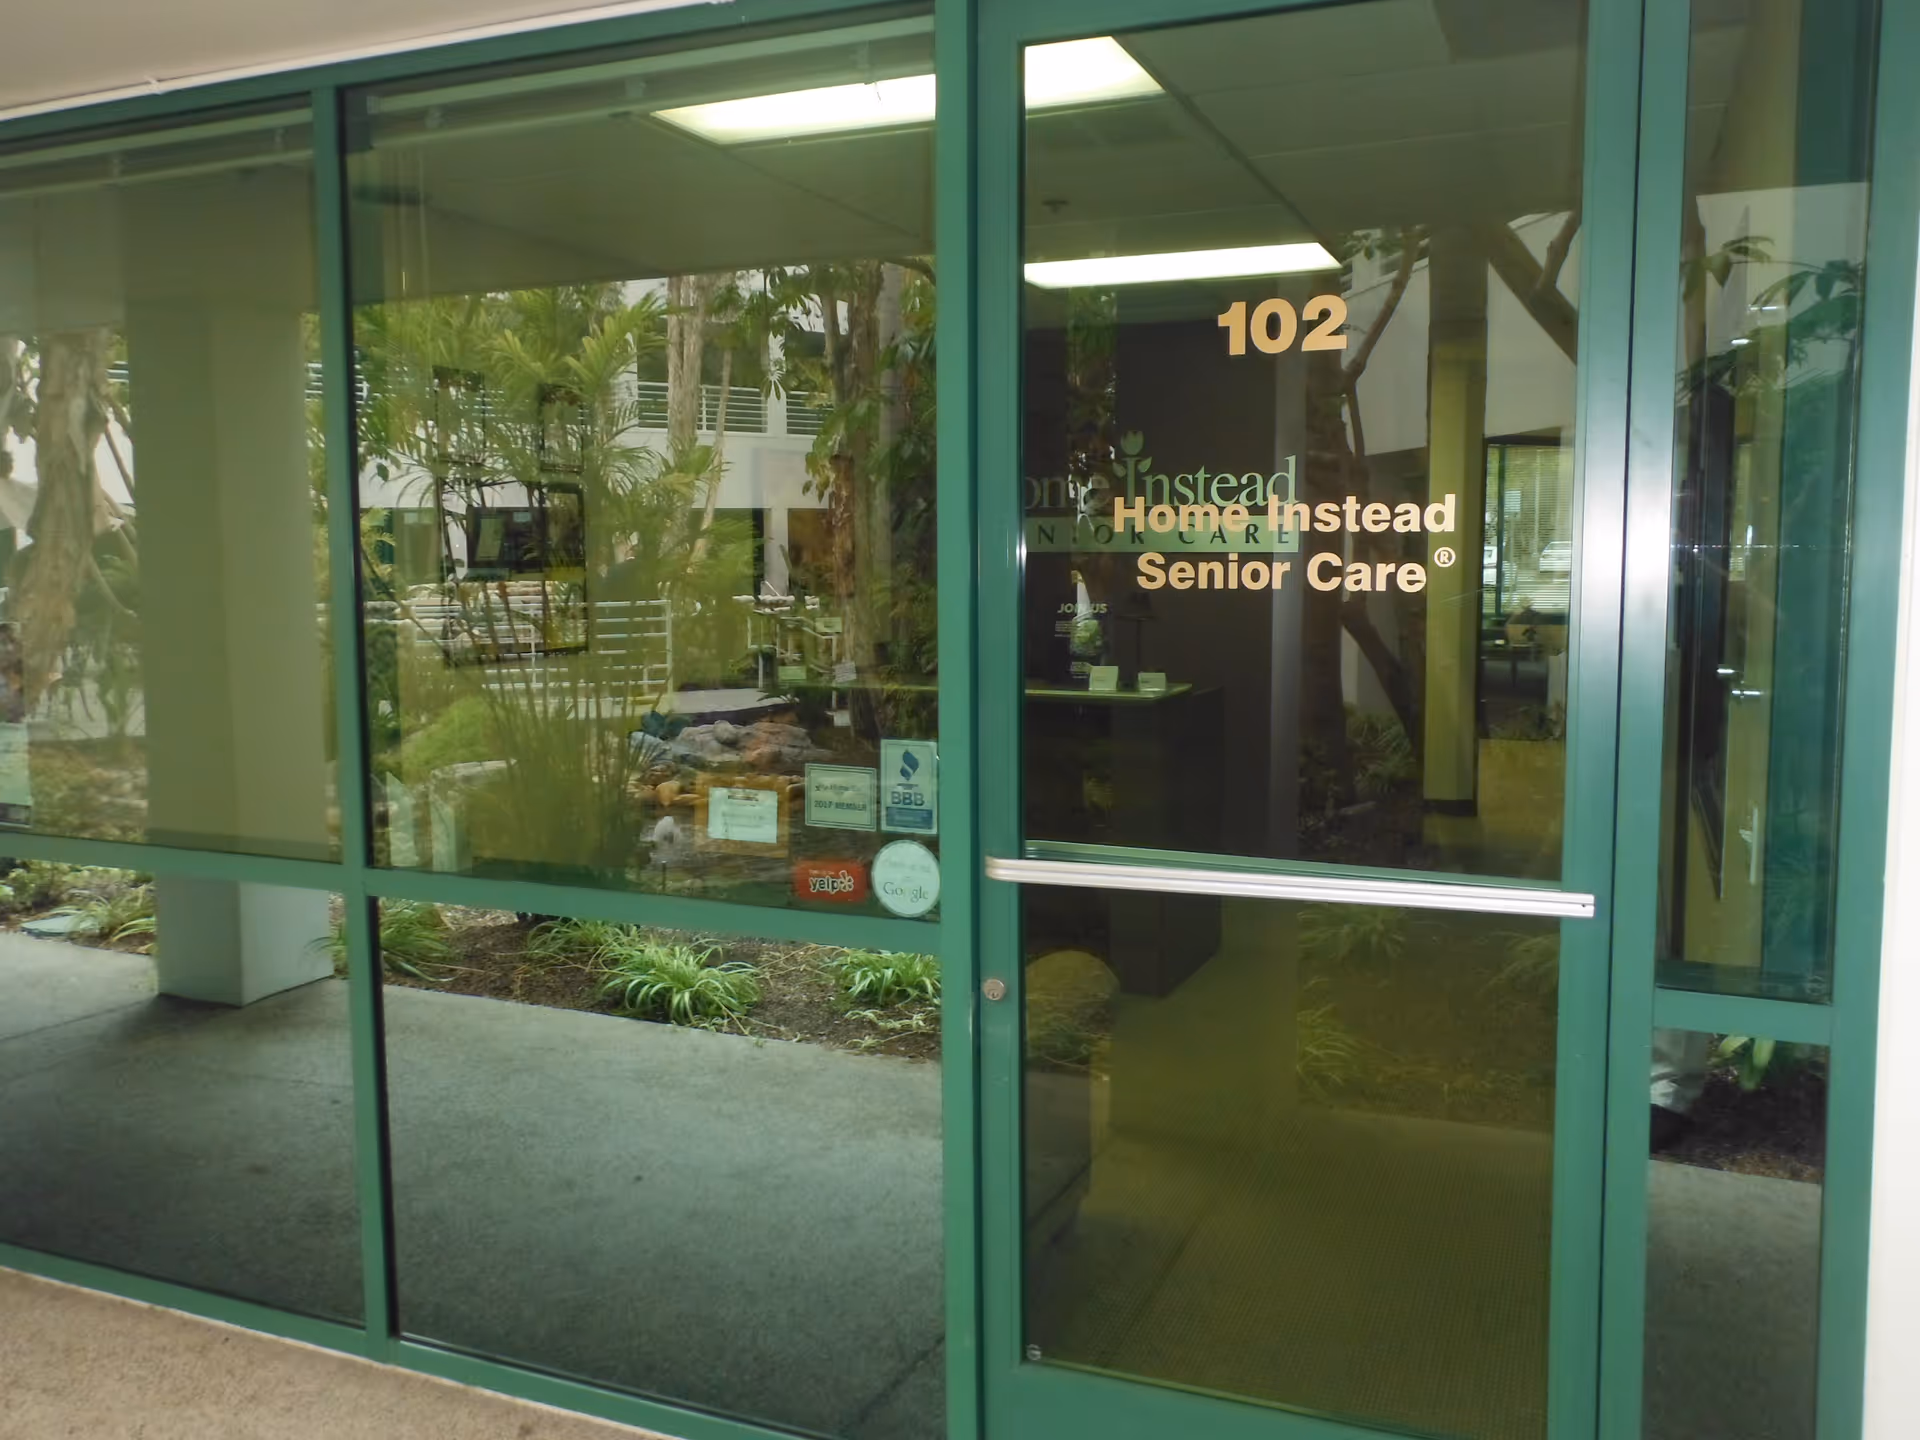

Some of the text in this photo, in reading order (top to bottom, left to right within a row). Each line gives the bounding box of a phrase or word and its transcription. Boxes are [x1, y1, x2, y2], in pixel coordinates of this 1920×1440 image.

[1218, 294, 1348, 356] 102
[1123, 454, 1301, 508] Instead
[1113, 493, 1457, 534] Home Instead
[1178, 523, 1291, 545] CARE
[1136, 551, 1291, 591] Senior
[1057, 602, 1109, 614] JOI US
[813, 800, 833, 809] 2017
[890, 790, 926, 807] BBB
[809, 875, 841, 895] yelp
